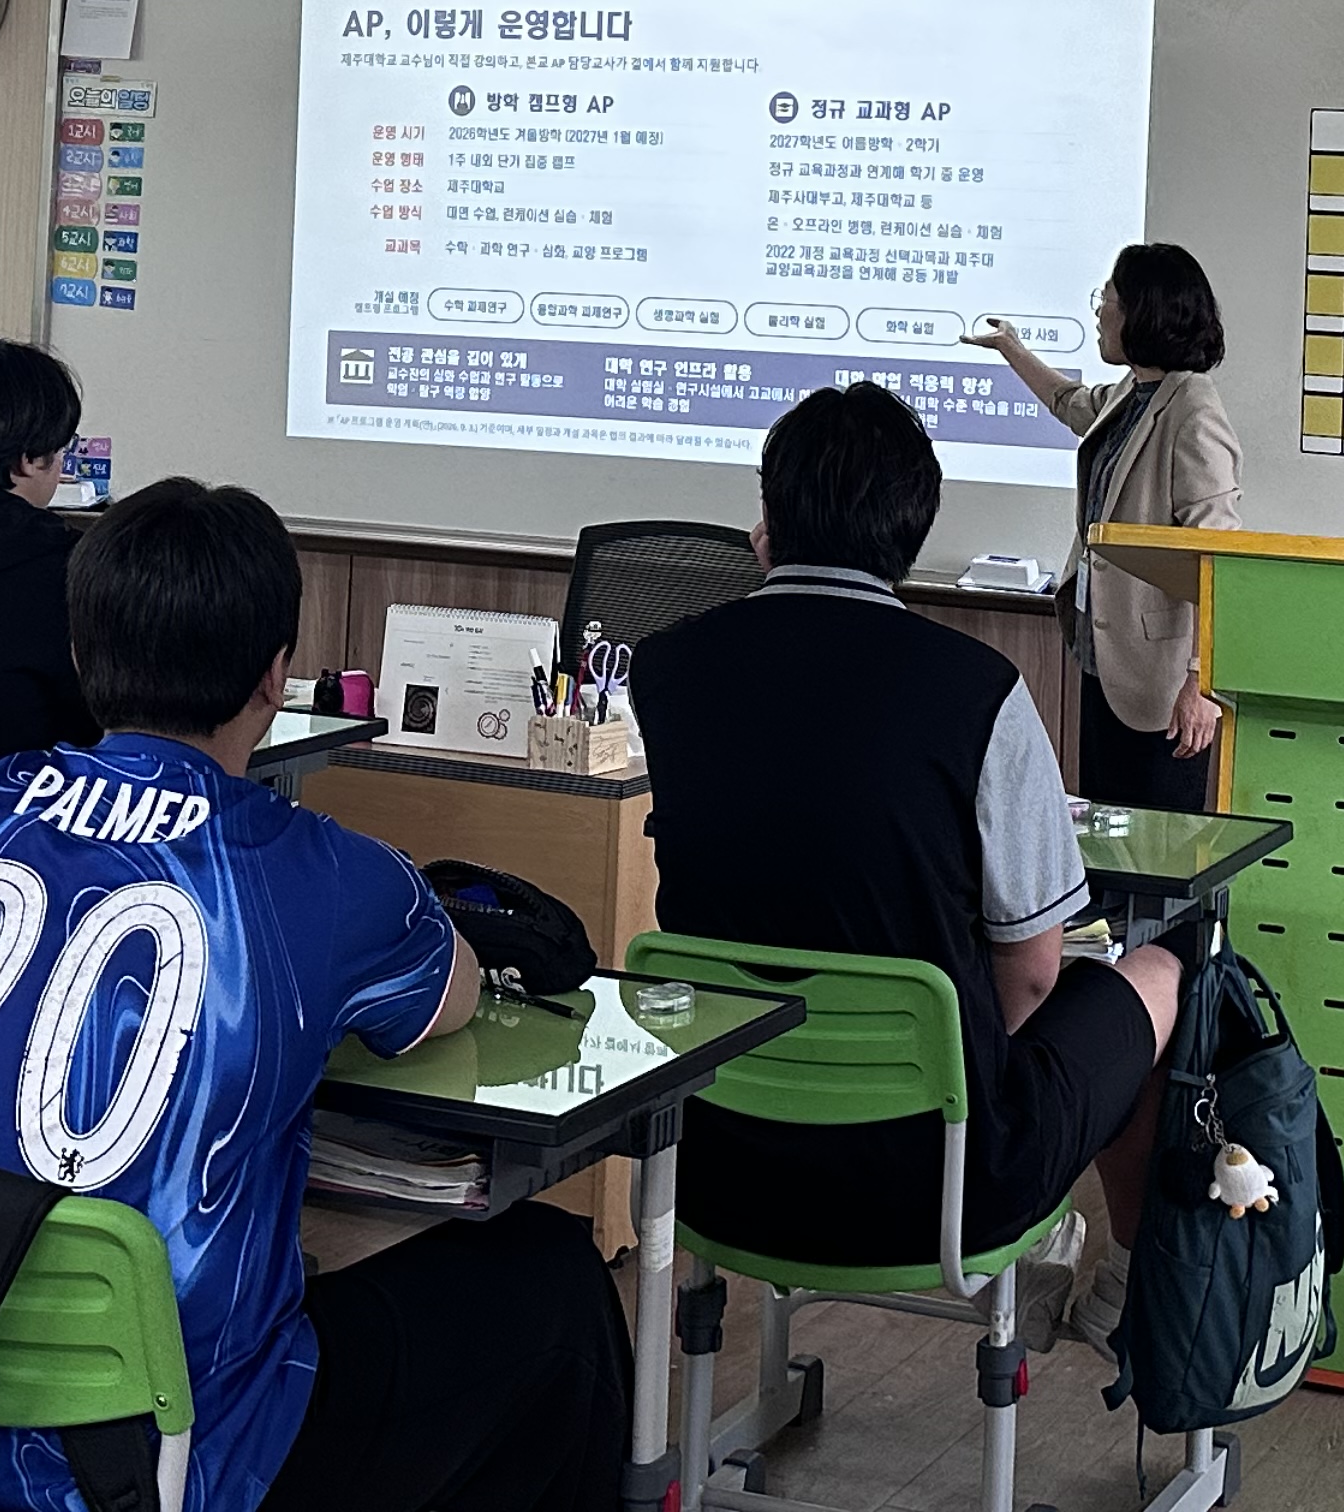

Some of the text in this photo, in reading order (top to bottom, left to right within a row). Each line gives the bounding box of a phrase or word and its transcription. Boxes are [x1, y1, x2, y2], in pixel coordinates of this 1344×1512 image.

[342, 9, 632, 42] AP, 이렇게 운영합니다
[340, 52, 397, 67] 제주대학교
[400, 53, 445, 68] 교수님이
[448, 54, 470, 69] 직접
[474, 54, 523, 70] 강의하고,
[526, 55, 549, 70] 본교
[568, 56, 627, 70] 담당교사가
[631, 57, 666, 72] 곁에서
[670, 57, 694, 71] 함께
[68, 86, 151, 111] 오늘의 일정
[486, 92, 614, 114] 방학 캠프형 AP
[811, 99, 952, 121] 정규 교과형 AP
[68, 124, 97, 139] 1교시
[372, 125, 425, 141] 운영 시기
[448, 127, 510, 142] 2026학년도
[514, 127, 562, 143] 겨울방학
[613, 131, 631, 145] 1월
[769, 134, 940, 153] 2027학년도 여름방학 2학기
[66, 150, 96, 166] 2교시
[372, 151, 424, 167] 운영 형태
[448, 154, 575, 170] 1주 내외 단기 집중 캠프
[768, 162, 984, 183] 정규 교육과정과 연계해 학기 중 운영
[371, 179, 423, 194] 수업 장소
[447, 179, 505, 194] 제주대학교
[851, 192, 916, 208] 제주대학교
[920, 194, 933, 209] 등
[369, 205, 422, 221] 수업 방식
[447, 206, 469, 221] 대면
[553, 209, 577, 224] 실습
[588, 210, 613, 225] 체험
[767, 217, 779, 232] 온
[792, 217, 843, 234] 오프라인
[938, 223, 963, 239] 실습
[976, 224, 1002, 240] 체험
[61, 231, 91, 247] 5교시
[445, 240, 468, 255] 수학
[480, 242, 503, 256] 과학
[506, 243, 530, 258] 연구
[572, 246, 596, 261] 교양
[600, 246, 648, 262] 프로그램
[766, 244, 994, 267] 2022 개정 교육과정 선택과목과 제주대
[765, 263, 959, 284] 교양교육과정을 연계해 공동 개발
[374, 289, 419, 305] 개설 예정
[444, 300, 463, 312] 수학
[653, 310, 720, 325] 생명과학 실험
[804, 316, 826, 330] 실험
[886, 320, 934, 335] 화학 실험
[605, 357, 633, 375] 대학
[674, 361, 716, 379] 인프라
[1013, 401, 1038, 418] 미리
[14, 765, 210, 844] PALMER
